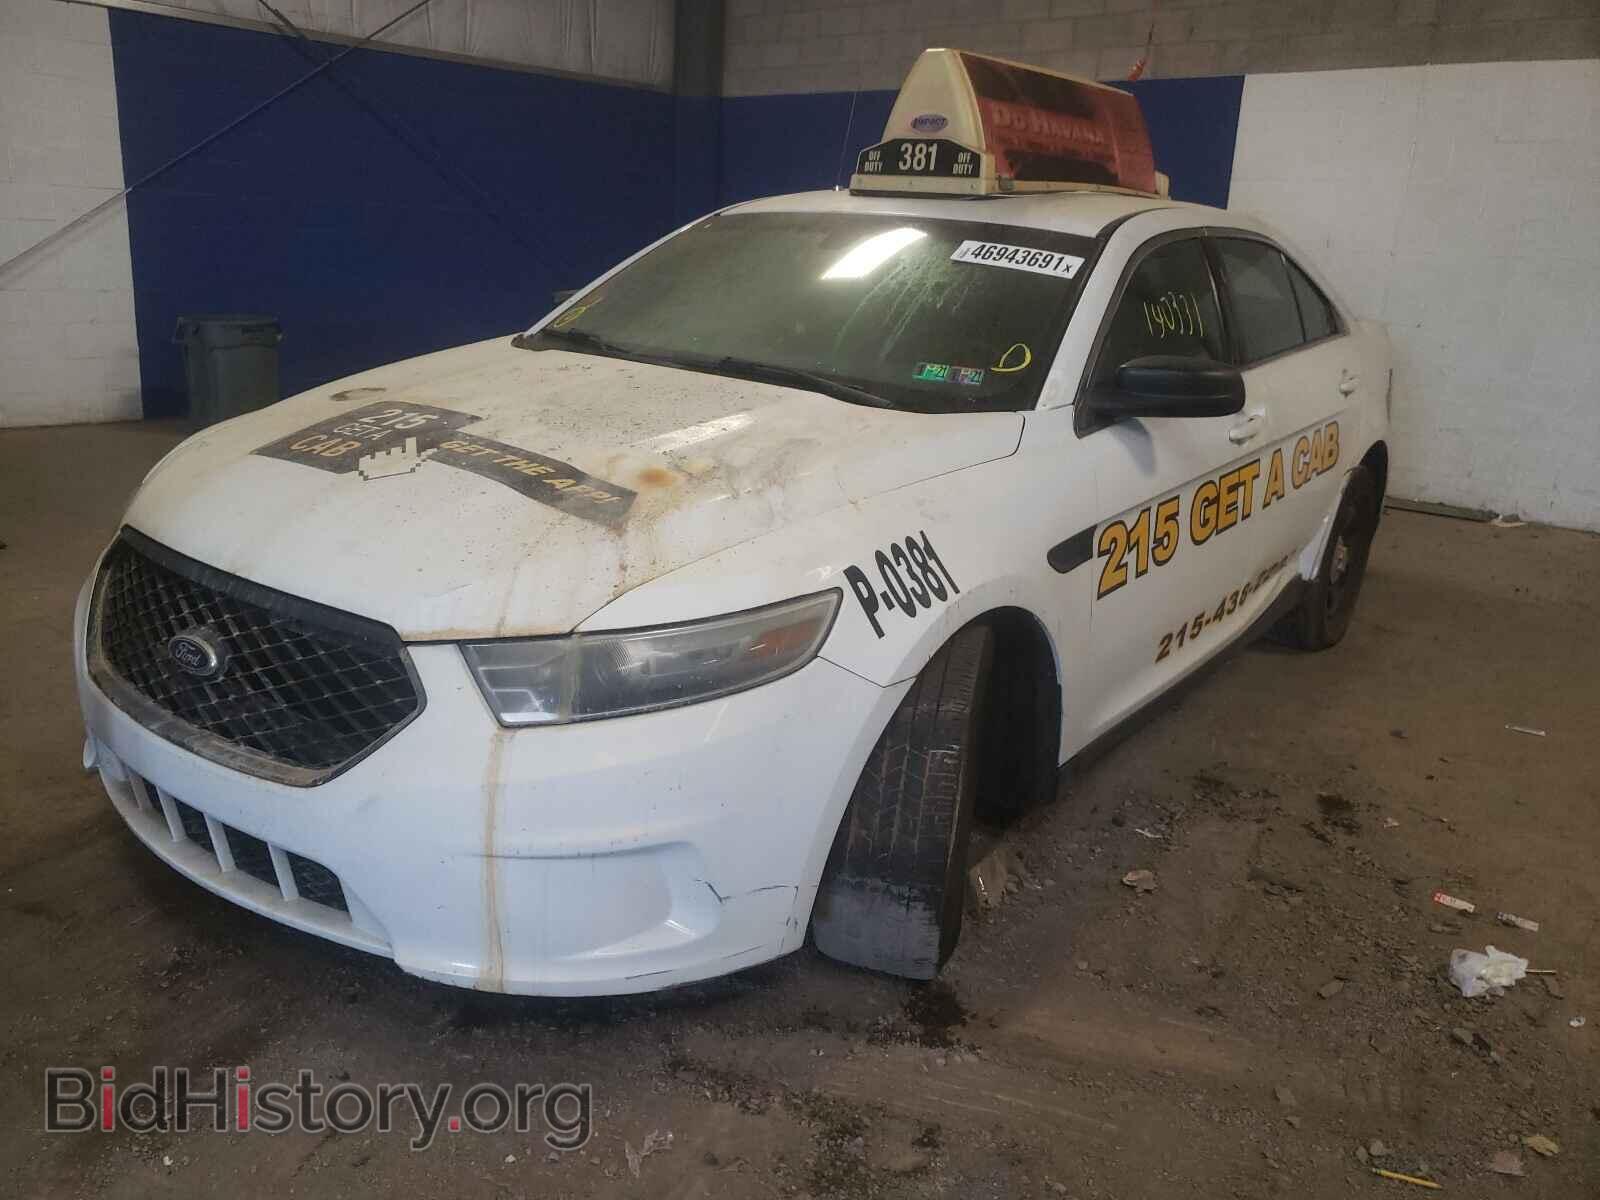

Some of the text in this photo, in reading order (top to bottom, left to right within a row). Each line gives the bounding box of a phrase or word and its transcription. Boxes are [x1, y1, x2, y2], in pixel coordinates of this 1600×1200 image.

[864, 161, 882, 172] DUTY
[868, 150, 881, 162] OFF
[898, 142, 938, 171] 381
[957, 151, 972, 163] OFF
[952, 163, 973, 175] DUTY
[970, 243, 1065, 271] 46943691
[358, 408, 440, 430] 215
[290, 434, 362, 457] CAB
[439, 440, 499, 457] GET
[493, 454, 556, 477] THE
[1096, 419, 1340, 601] 215 GET A CAB
[842, 529, 961, 640] P-0381
